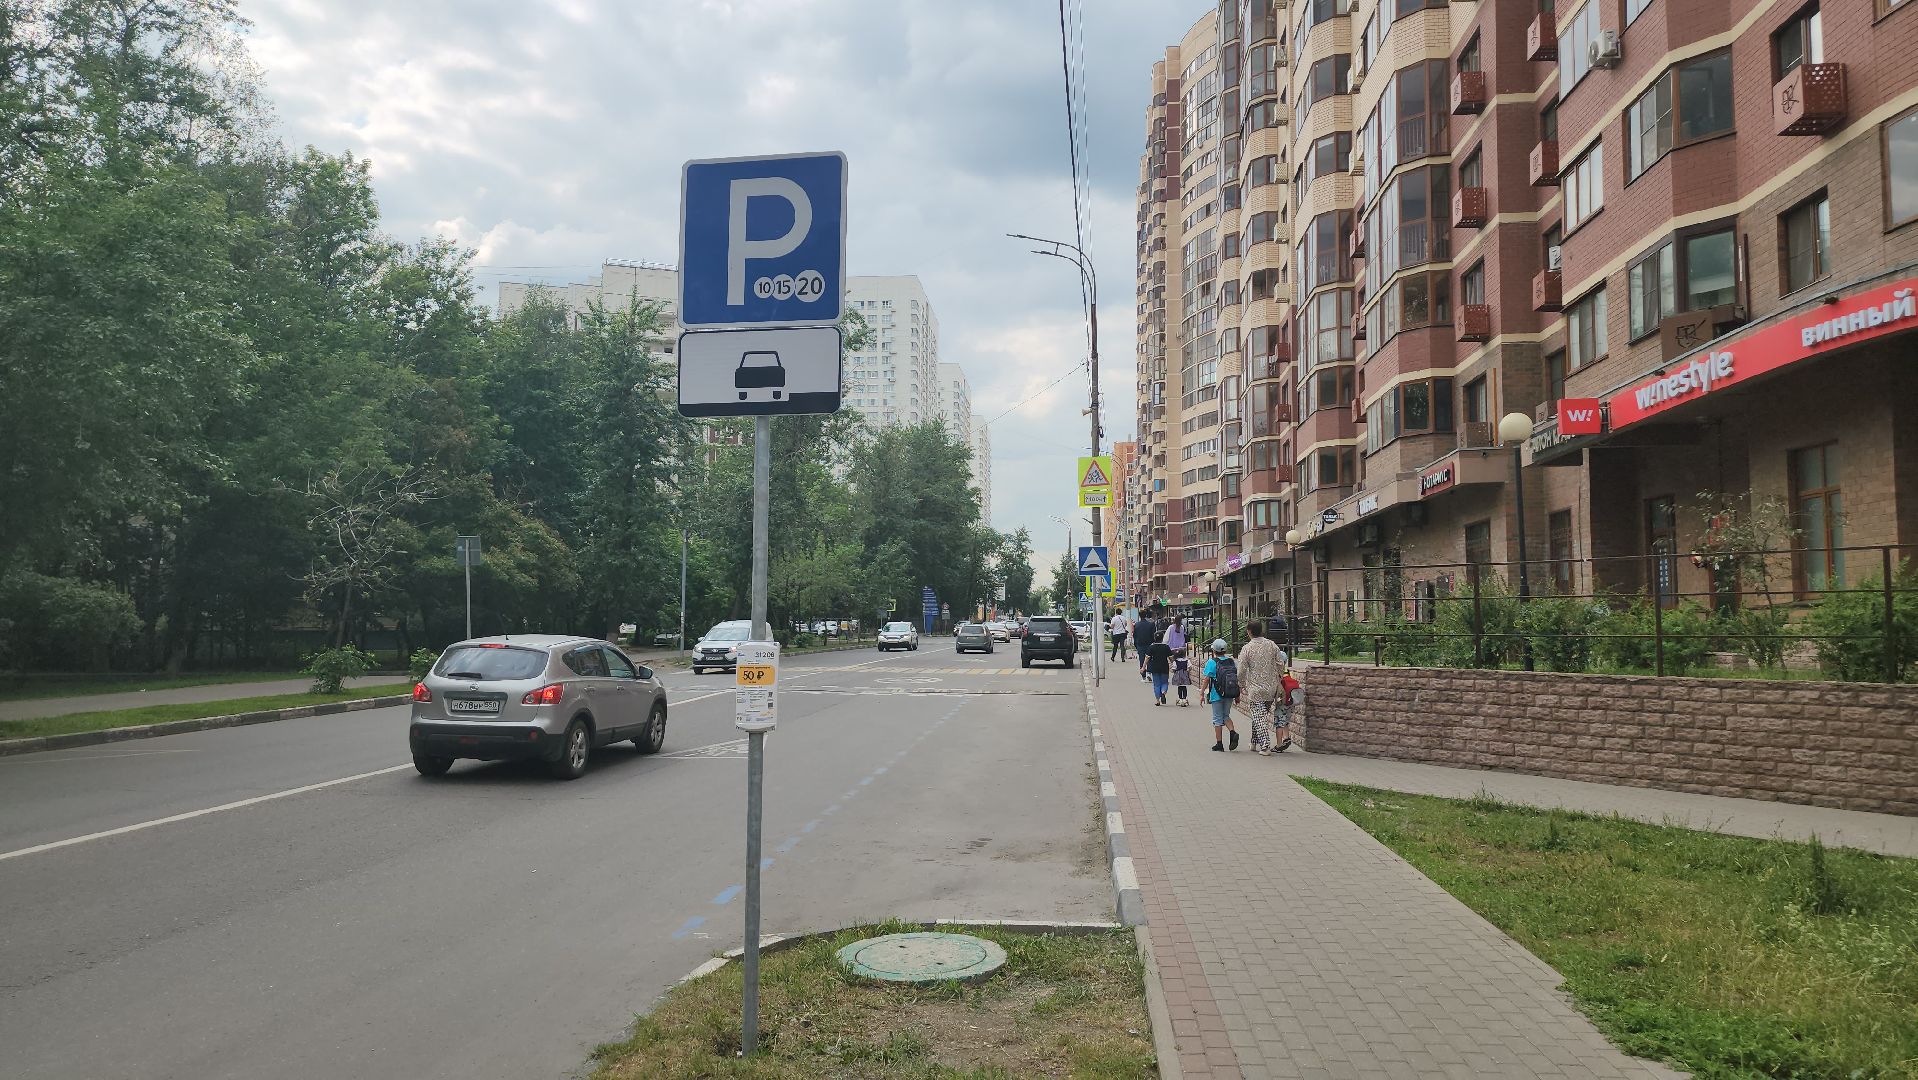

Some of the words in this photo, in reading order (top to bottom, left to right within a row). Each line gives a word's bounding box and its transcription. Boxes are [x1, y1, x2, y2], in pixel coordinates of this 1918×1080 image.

[727, 177, 812, 306] P
[759, 281, 771, 294] 10
[776, 280, 791, 295] 15
[797, 276, 823, 295] 20
[1801, 288, 1916, 347] винный
[743, 670, 755, 680] 50
